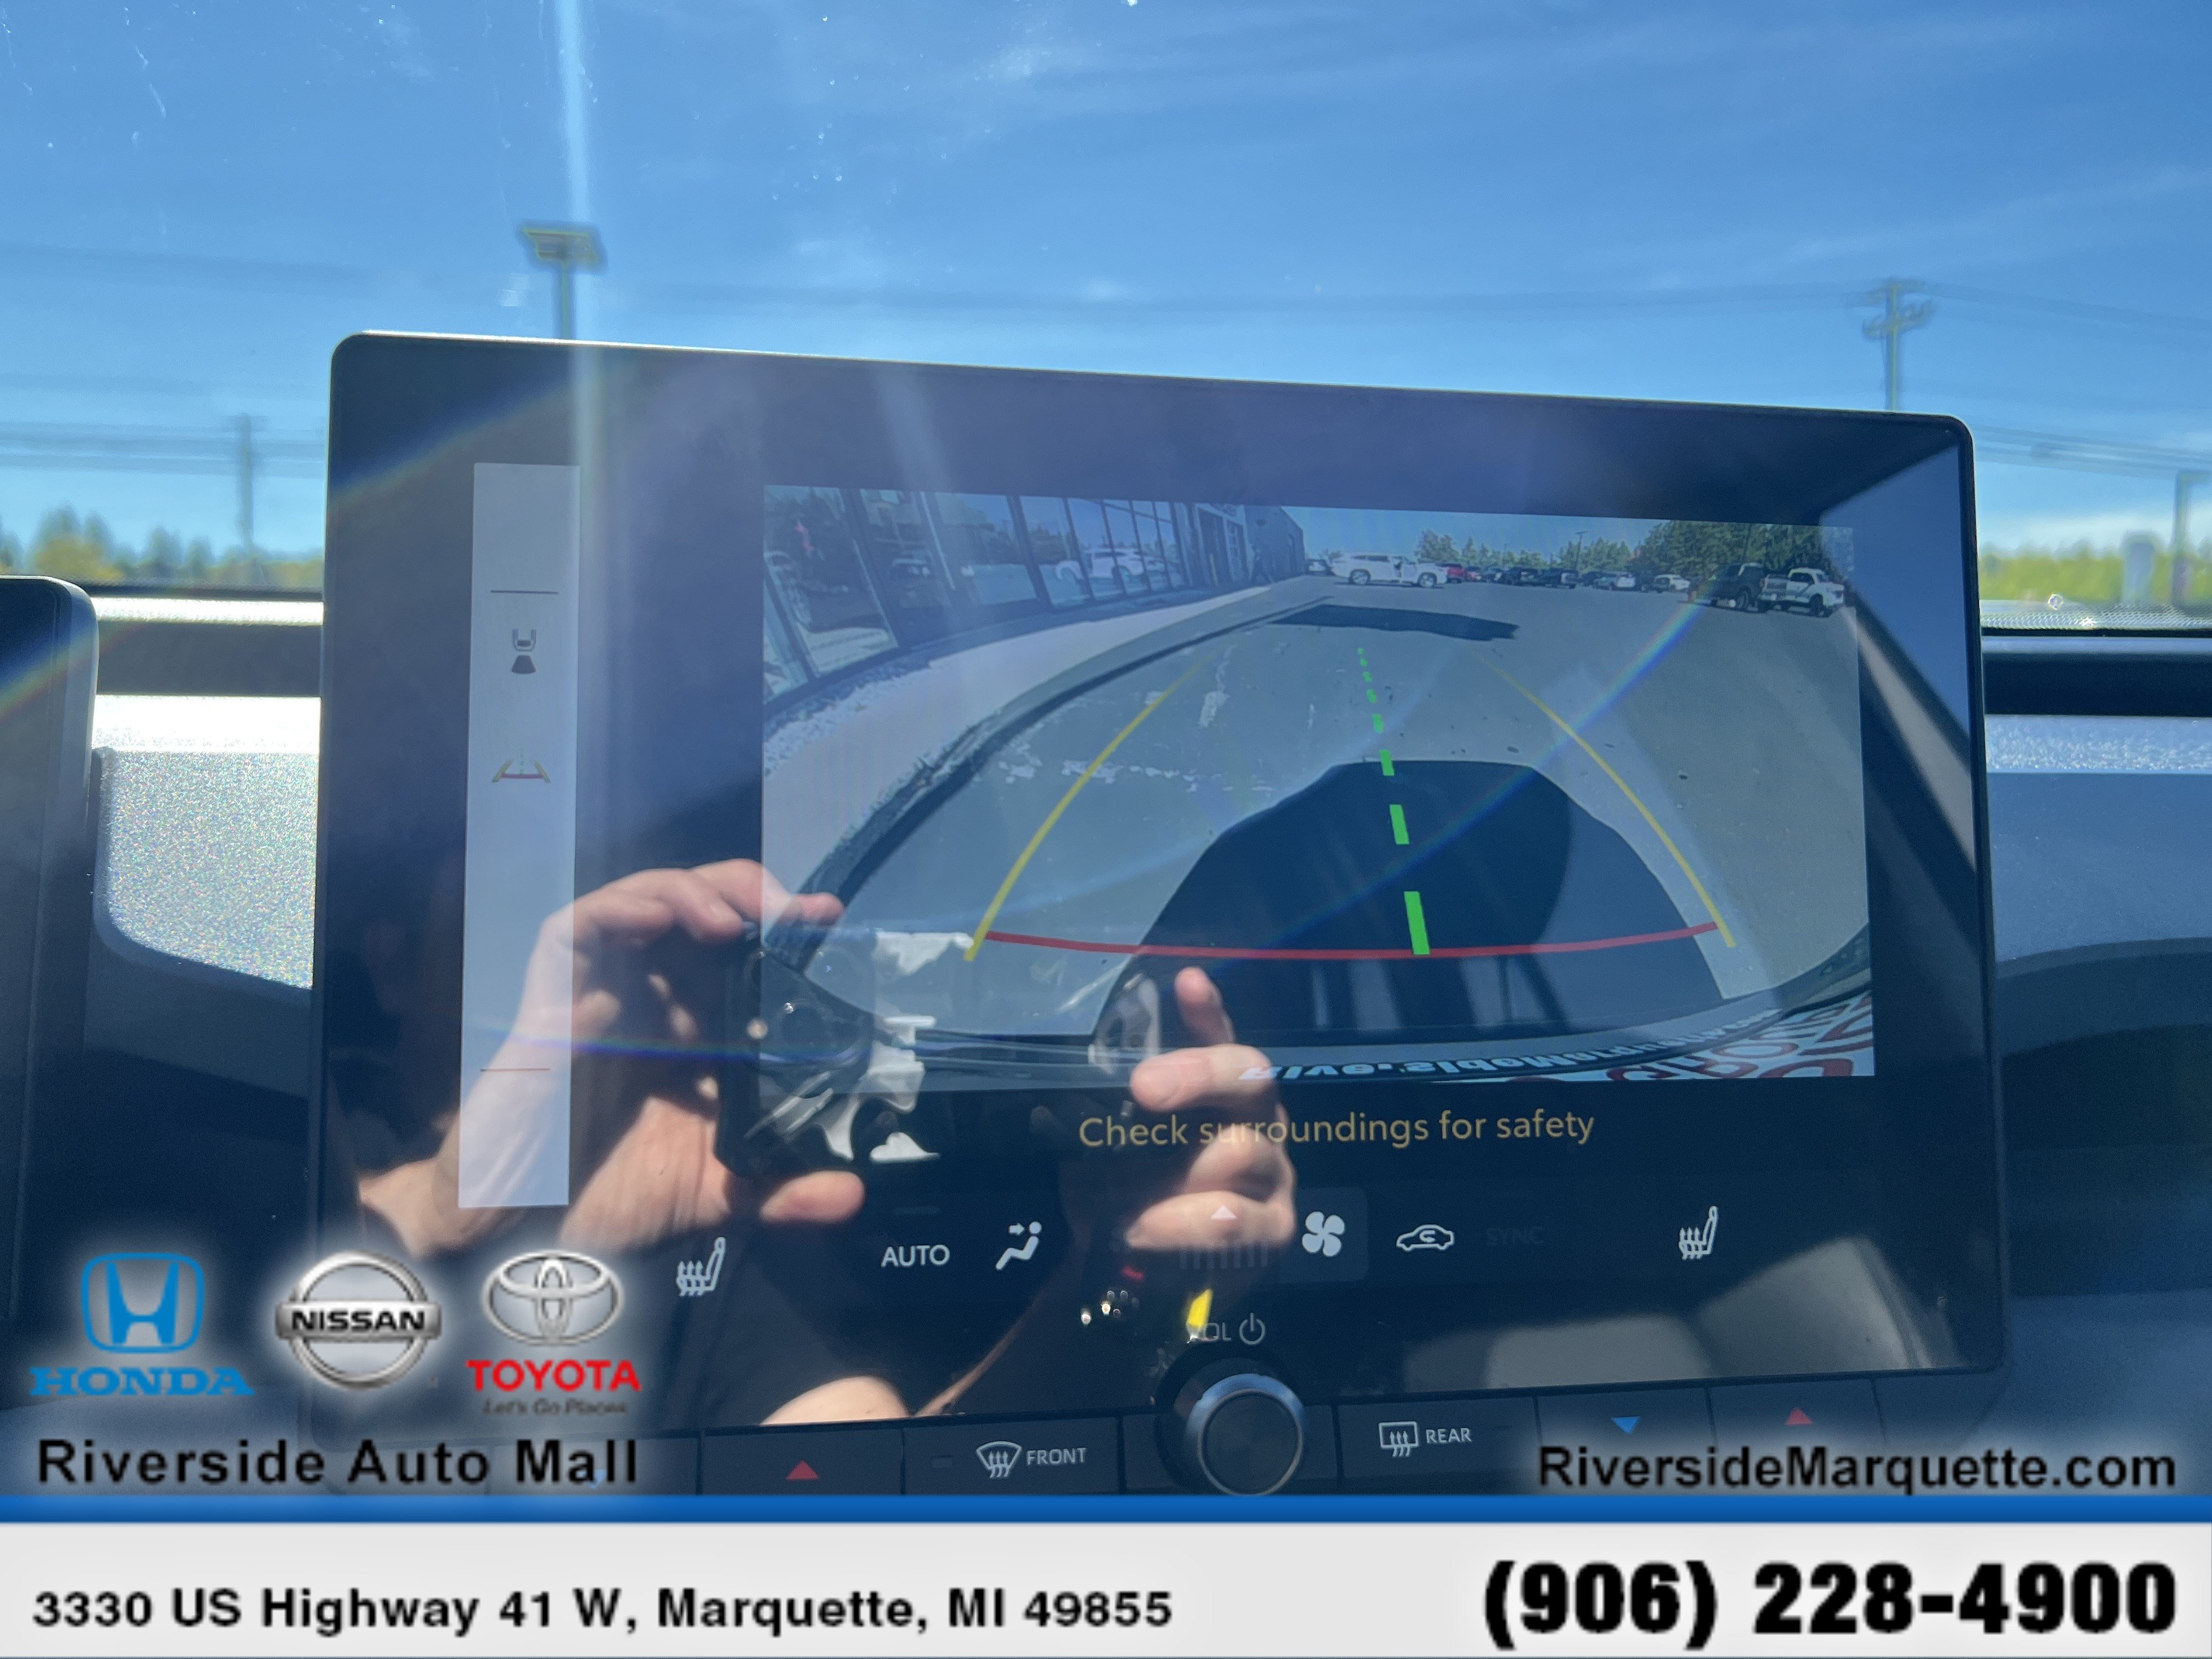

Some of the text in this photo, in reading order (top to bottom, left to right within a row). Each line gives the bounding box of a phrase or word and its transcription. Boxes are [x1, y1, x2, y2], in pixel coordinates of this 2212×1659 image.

[1079, 1108, 1595, 1149] Check surroundings for safety
[881, 1244, 950, 1267] AUTO
[1425, 1427, 1472, 1444] REAR
[1026, 1447, 1087, 1465] FRONT
